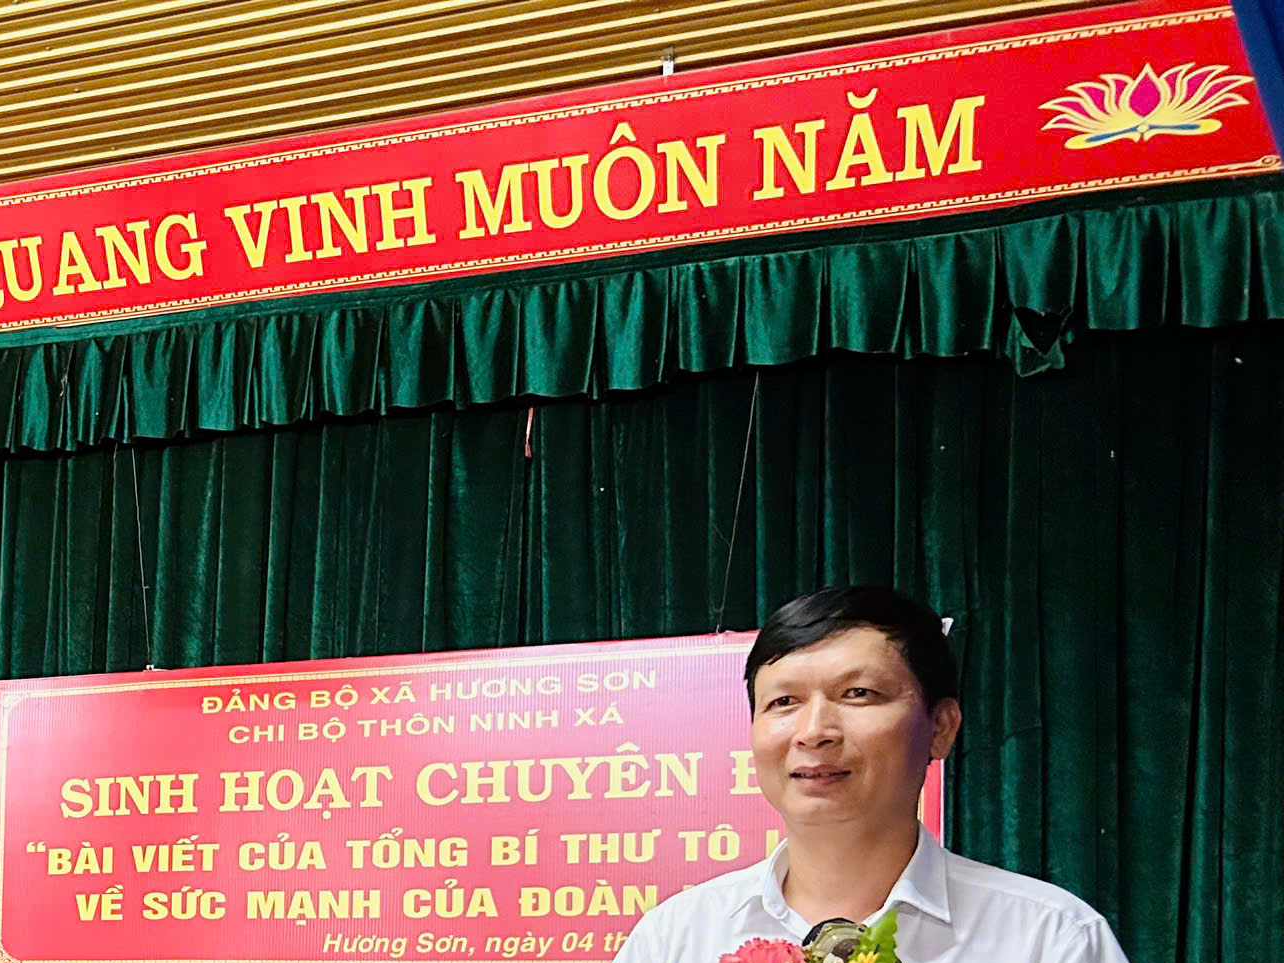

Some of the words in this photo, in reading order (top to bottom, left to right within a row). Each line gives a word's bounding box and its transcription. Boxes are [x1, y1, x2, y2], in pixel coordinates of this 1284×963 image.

[225, 176, 436, 269] VINH
[456, 122, 726, 241] MUÔN
[753, 87, 985, 201] NĂM
[201, 687, 297, 714] ĐẢNG
[309, 683, 358, 708] BỘ
[369, 680, 418, 705] XÃ
[429, 678, 563, 701] HƯƠNG
[577, 669, 657, 692] SƠN
[228, 724, 285, 745] CHI
[298, 717, 347, 743] BỘ
[357, 713, 456, 737] THÔN
[469, 710, 559, 732] NINH
[573, 702, 625, 726] XÁ
[60, 773, 199, 819] SINH
[219, 765, 394, 820] HOẠT
[415, 741, 703, 806] CHUYÊN
[729, 750, 764, 795] Đ
[26, 841, 114, 875] “BÀI
[132, 834, 221, 873] VIẾT
[238, 832, 327, 871] CỦA
[346, 827, 469, 869] TỔNG
[491, 829, 538, 866] BÍ
[560, 828, 662, 865] THƯ
[678, 823, 741, 862] TÔ
[75, 884, 124, 921] VỀ
[142, 886, 226, 921] SỨC
[246, 889, 381, 926] MẠNH
[402, 879, 499, 919] CỦA
[519, 879, 658, 917] ĐOÀN
[322, 934, 408, 959] Hương
[415, 932, 476, 958] Sơn,
[485, 931, 555, 960] ngày
[561, 932, 594, 954] 04
